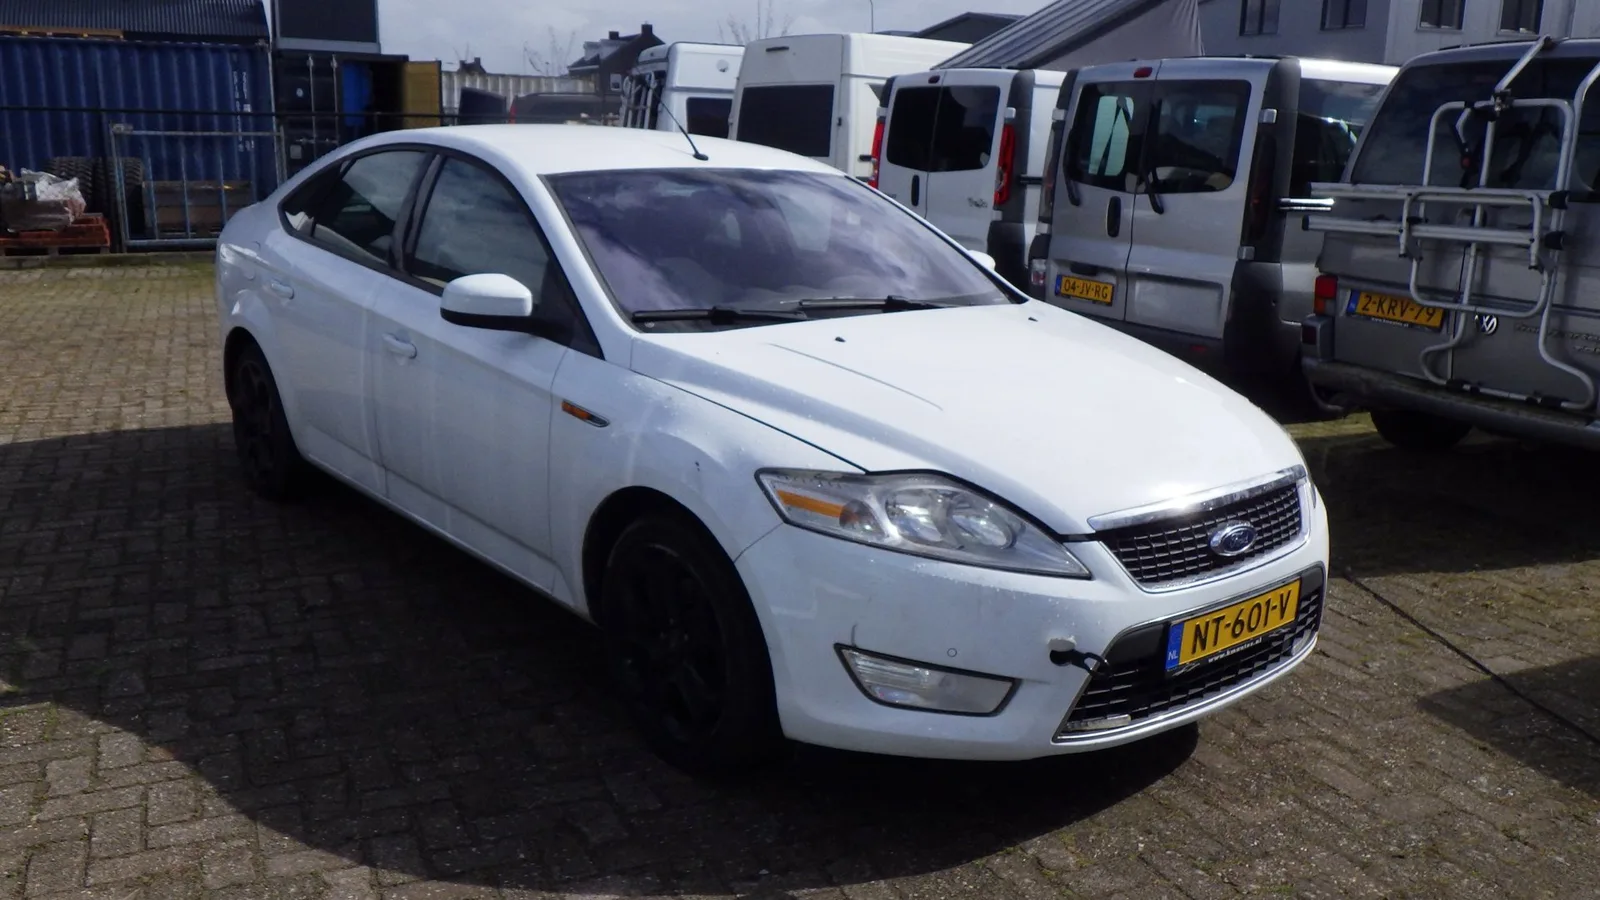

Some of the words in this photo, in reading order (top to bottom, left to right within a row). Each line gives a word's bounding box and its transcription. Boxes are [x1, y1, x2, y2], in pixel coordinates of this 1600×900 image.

[1064, 279, 1108, 299] 04-JV-RG
[1362, 294, 1437, 322] 2-KRV-79
[1191, 589, 1292, 655] NT-601-V
[1168, 650, 1179, 661] NL
